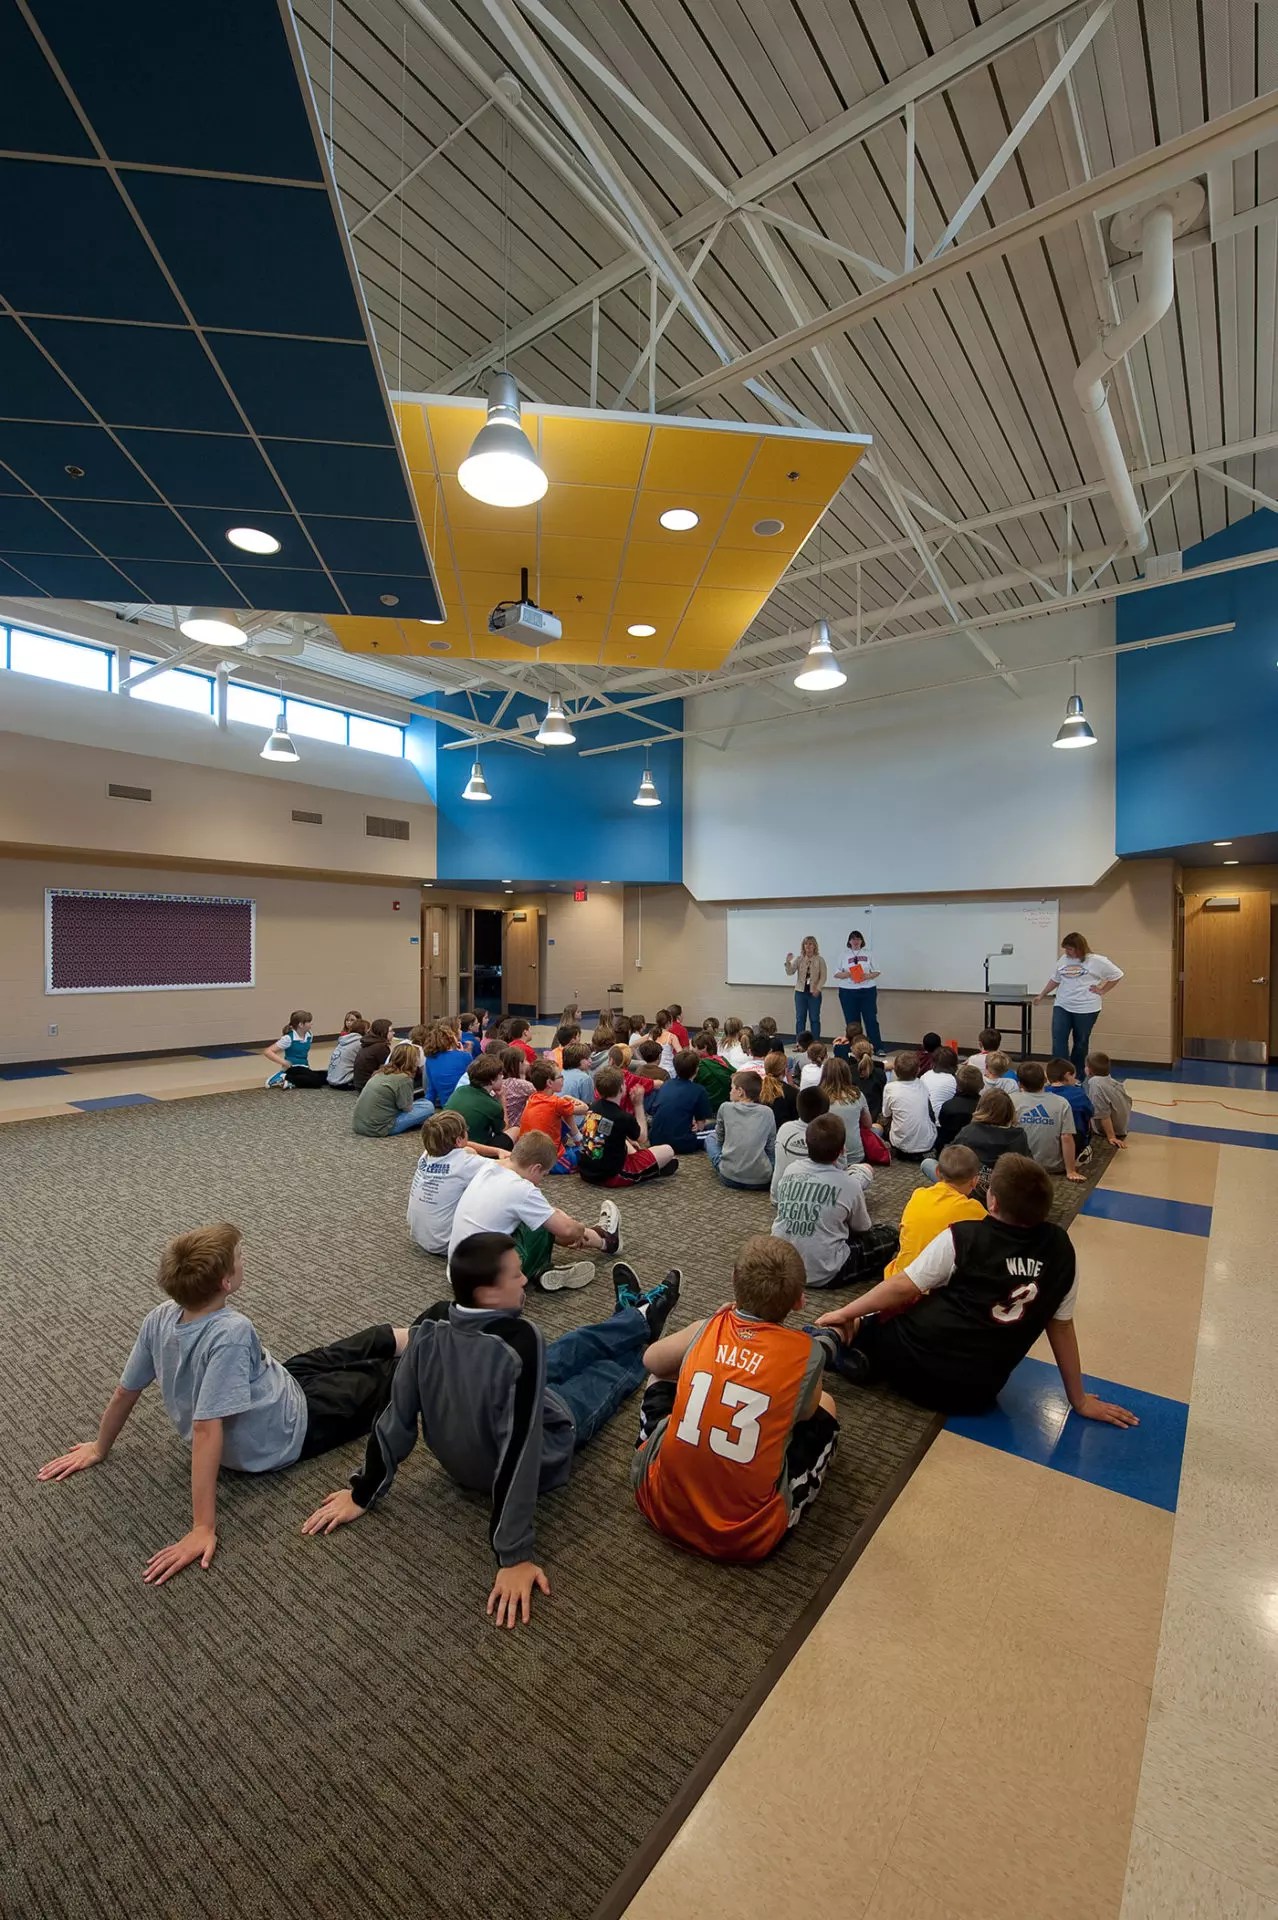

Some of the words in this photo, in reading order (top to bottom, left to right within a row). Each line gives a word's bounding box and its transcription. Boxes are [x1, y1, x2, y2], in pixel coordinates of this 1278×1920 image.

[1020, 1116, 1055, 1126] adidas
[779, 1181, 842, 1208] RADITION
[785, 1220, 816, 1237] 2009
[1006, 1257, 1044, 1277] WADE
[992, 1282, 1038, 1322] 3
[715, 1344, 764, 1375] NASH
[676, 1370, 772, 1464] 13
